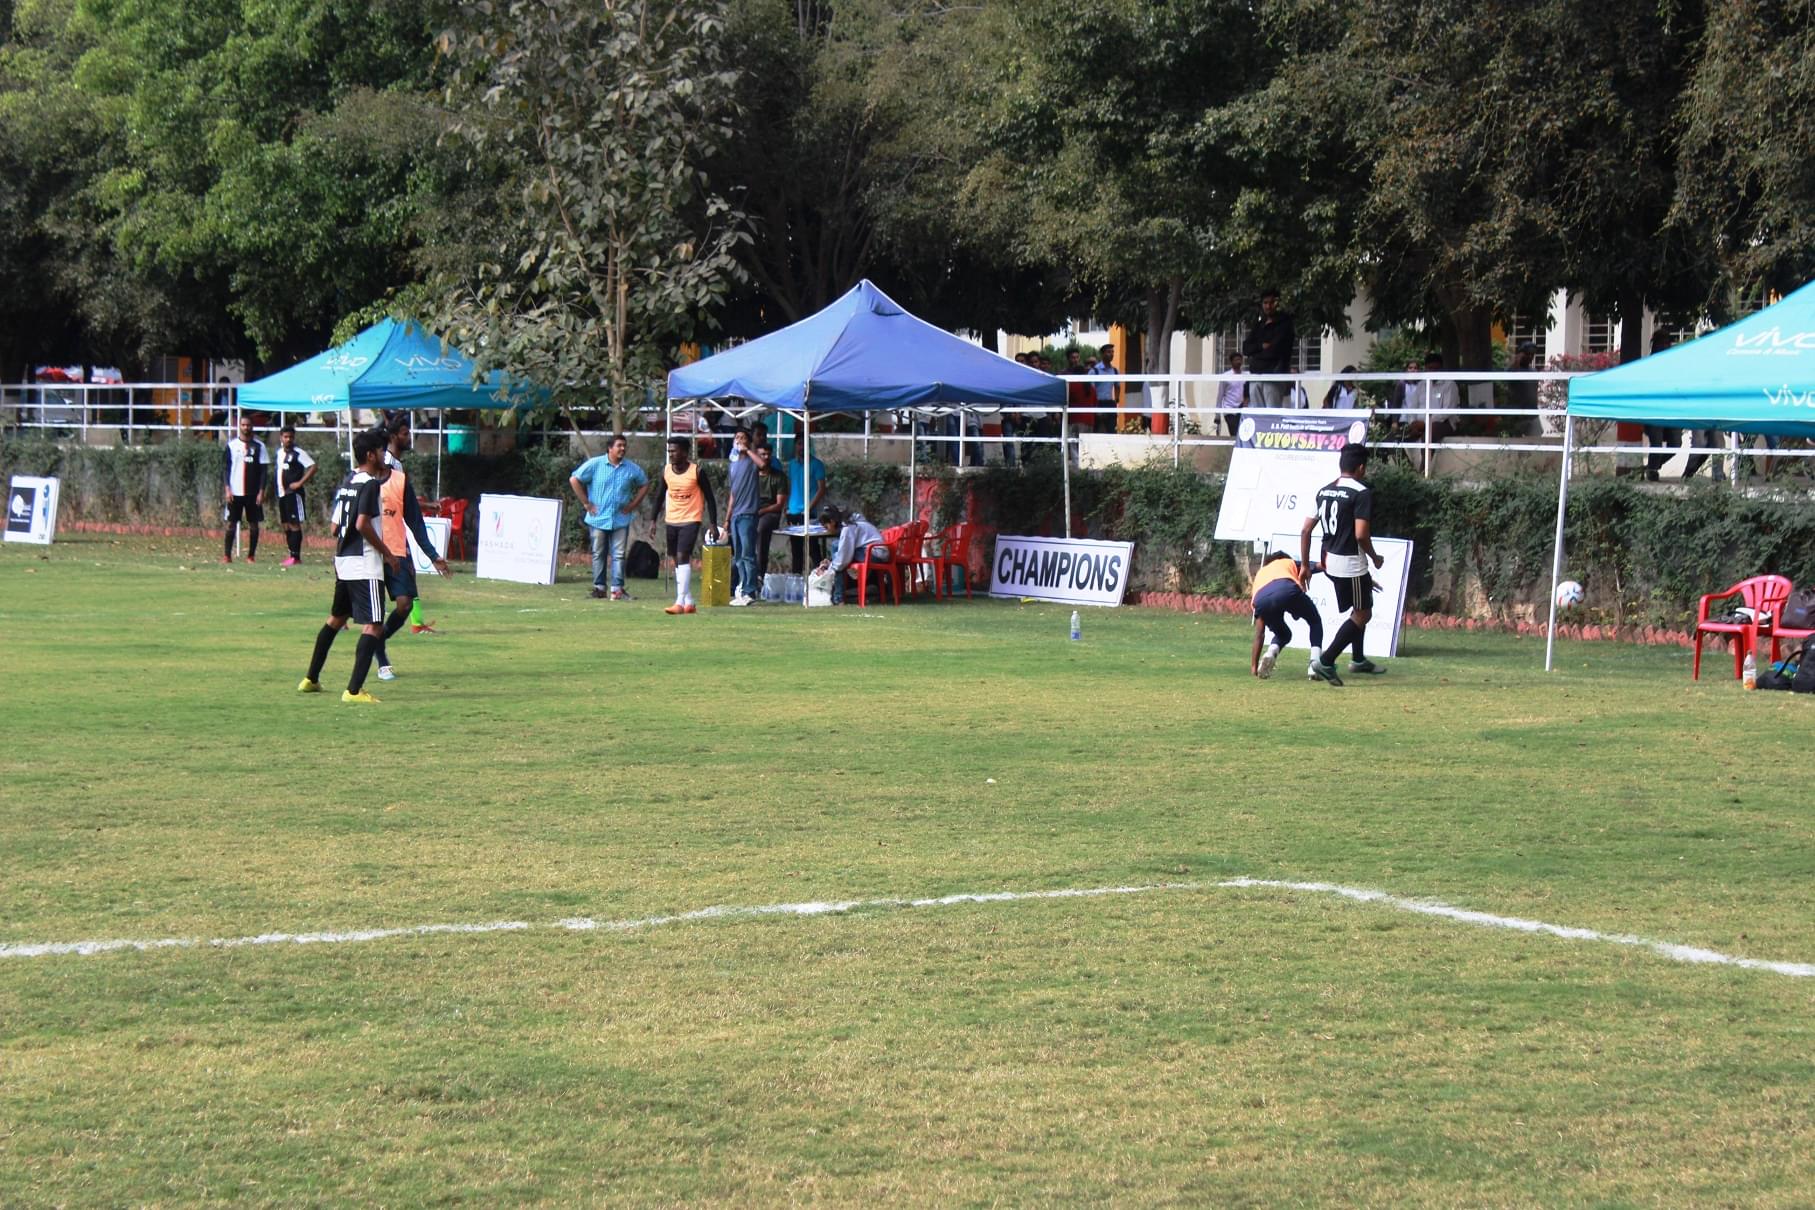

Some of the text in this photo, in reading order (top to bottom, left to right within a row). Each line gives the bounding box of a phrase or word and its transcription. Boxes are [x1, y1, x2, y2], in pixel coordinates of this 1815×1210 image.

[395, 354, 462, 369] vivo
[1275, 493, 1298, 511] V/S
[1318, 499, 1338, 535] 18
[998, 548, 1121, 592] CHAMPIONS
